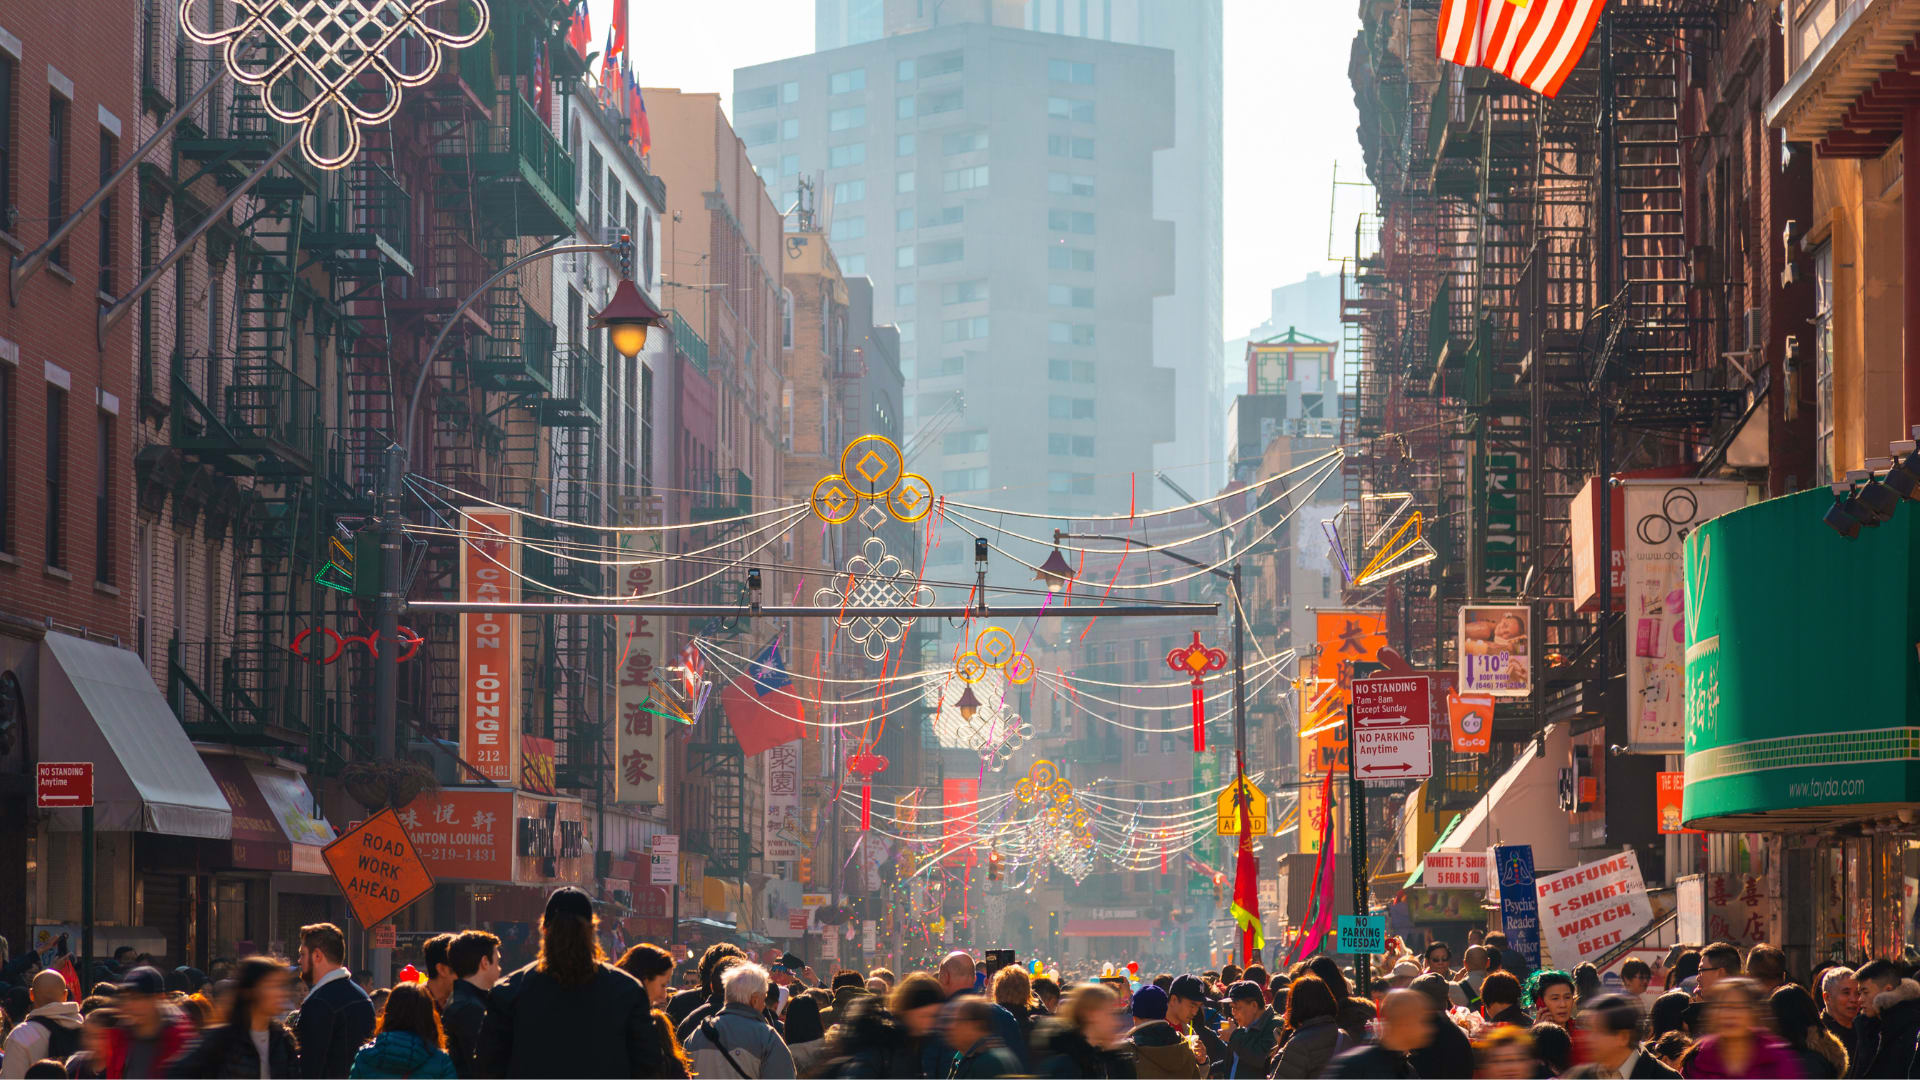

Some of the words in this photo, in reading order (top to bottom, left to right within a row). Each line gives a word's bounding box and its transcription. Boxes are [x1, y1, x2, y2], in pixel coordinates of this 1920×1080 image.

[1356, 684, 1369, 694] NO
[1371, 682, 1417, 694] STANDING
[475, 664, 500, 745] LOUNGE
[1356, 696, 1372, 705] 7am
[1378, 695, 1394, 704] 8am
[1356, 705, 1380, 715] Except
[1382, 704, 1407, 714] Sunday
[1359, 734, 1372, 743] NO
[1374, 732, 1415, 742] PARKING
[478, 750, 500, 762] 212
[1360, 744, 1399, 756] Anytime
[40, 767, 50, 776] NO
[51, 767, 84, 776] STANDING
[40, 777, 68, 788] Anytime
[1789, 777, 1865, 800] www.fayda.com
[362, 832, 405, 858] ROAD
[410, 832, 447, 845] ANTON
[449, 833, 494, 846] LOUNGE
[357, 853, 401, 881] WORK
[1427, 856, 1453, 868] WHITE
[1438, 872, 1444, 883] 5
[1445, 872, 1460, 883] FOR
[1538, 855, 1630, 898] PERFUME
[346, 876, 401, 904] AHEAD
[1548, 879, 1628, 918] T-SHIRT
[1504, 896, 1536, 915] Psychic
[1355, 917, 1368, 927] NO
[1506, 915, 1536, 930] Reader
[1557, 903, 1632, 939] WATCH
[1342, 927, 1381, 938] PARKING
[1341, 937, 1381, 949] TUESDAY
[1577, 929, 1622, 956] BELT
